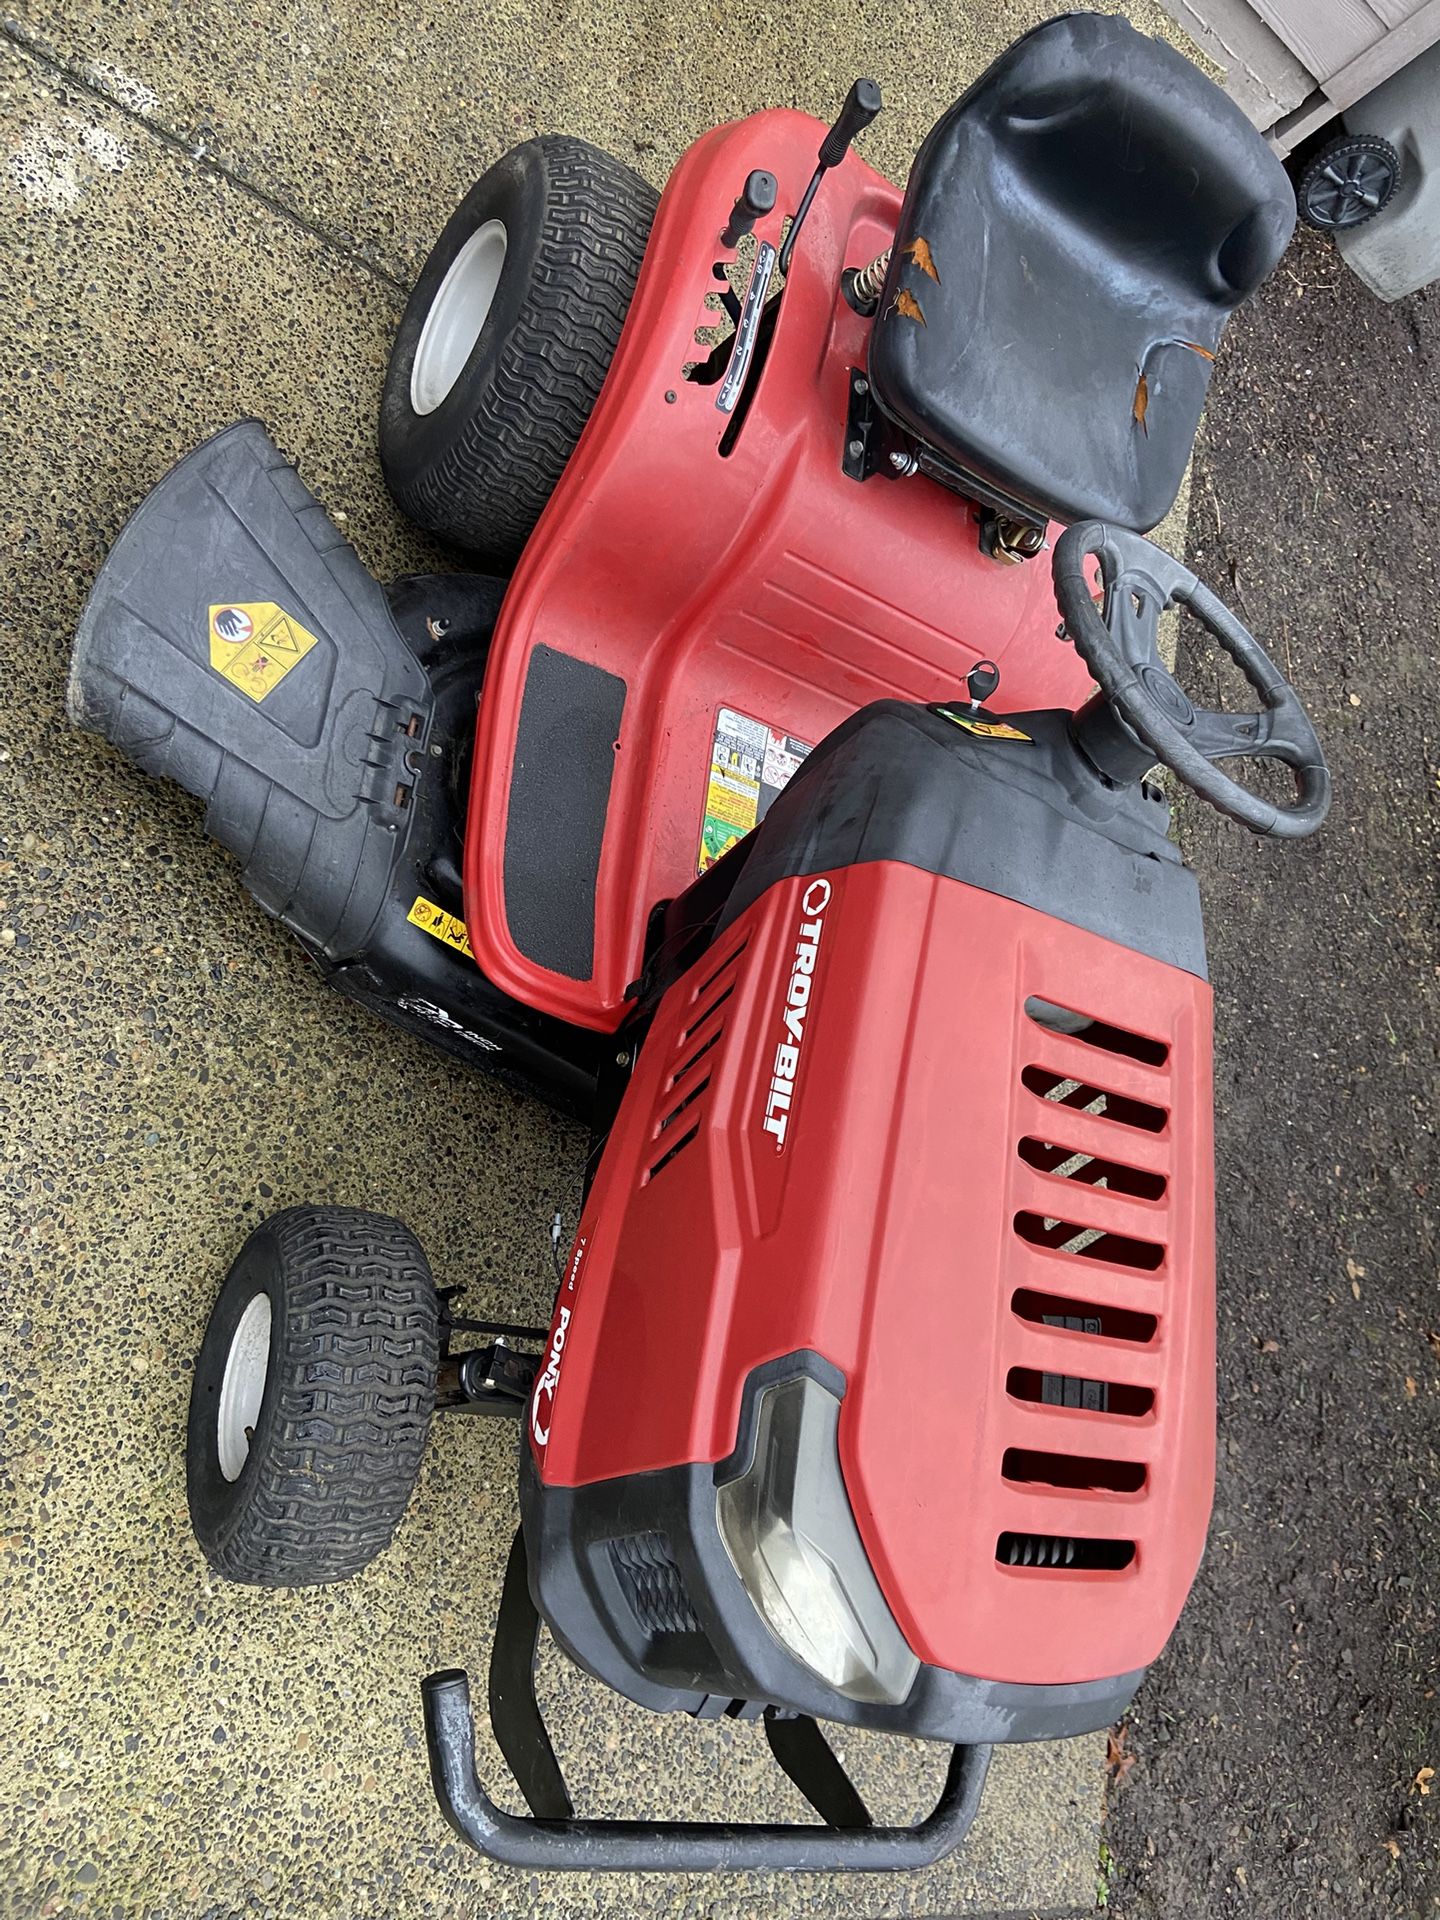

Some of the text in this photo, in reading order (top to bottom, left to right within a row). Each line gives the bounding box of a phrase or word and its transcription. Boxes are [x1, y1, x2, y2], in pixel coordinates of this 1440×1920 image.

[749, 291, 756, 301] 4
[743, 318, 749, 329] 3
[464, 1030, 503, 1051] INCH
[763, 918, 823, 1145] TROY-BILT
[568, 1237, 587, 1291] 7 Speed
[543, 1305, 571, 1401] PONY
